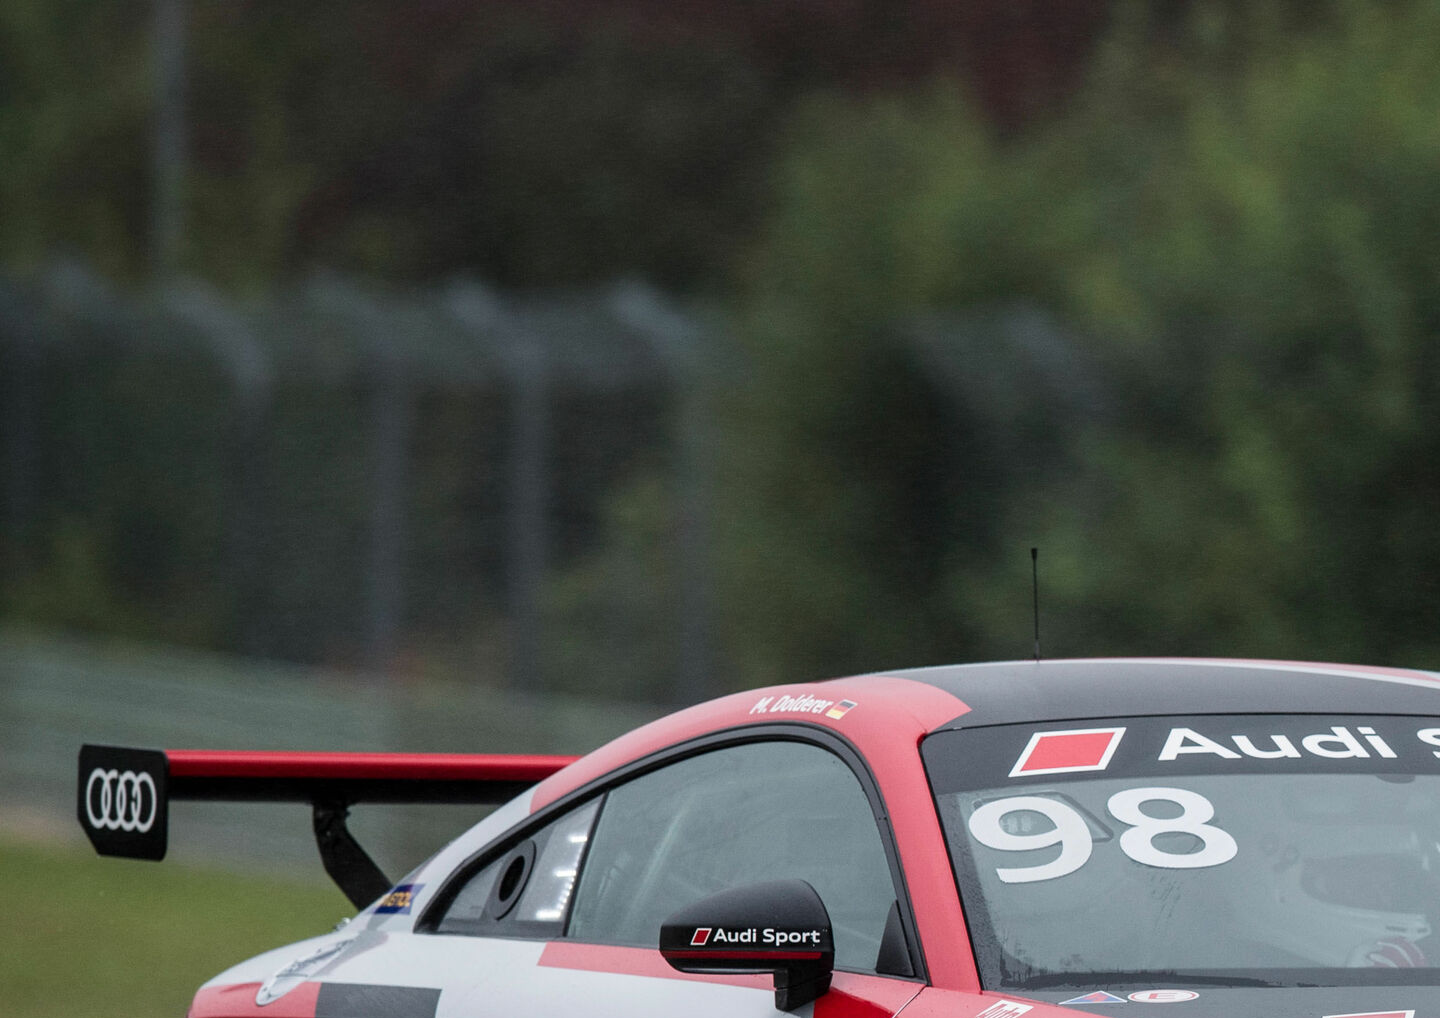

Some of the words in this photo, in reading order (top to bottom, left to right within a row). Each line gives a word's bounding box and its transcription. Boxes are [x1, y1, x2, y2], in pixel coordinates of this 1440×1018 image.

[770, 694, 834, 714] Dolderer
[1158, 727, 1398, 760] Audi
[968, 784, 1238, 883] 98
[713, 928, 757, 943] Audi
[762, 928, 820, 947] Sport
